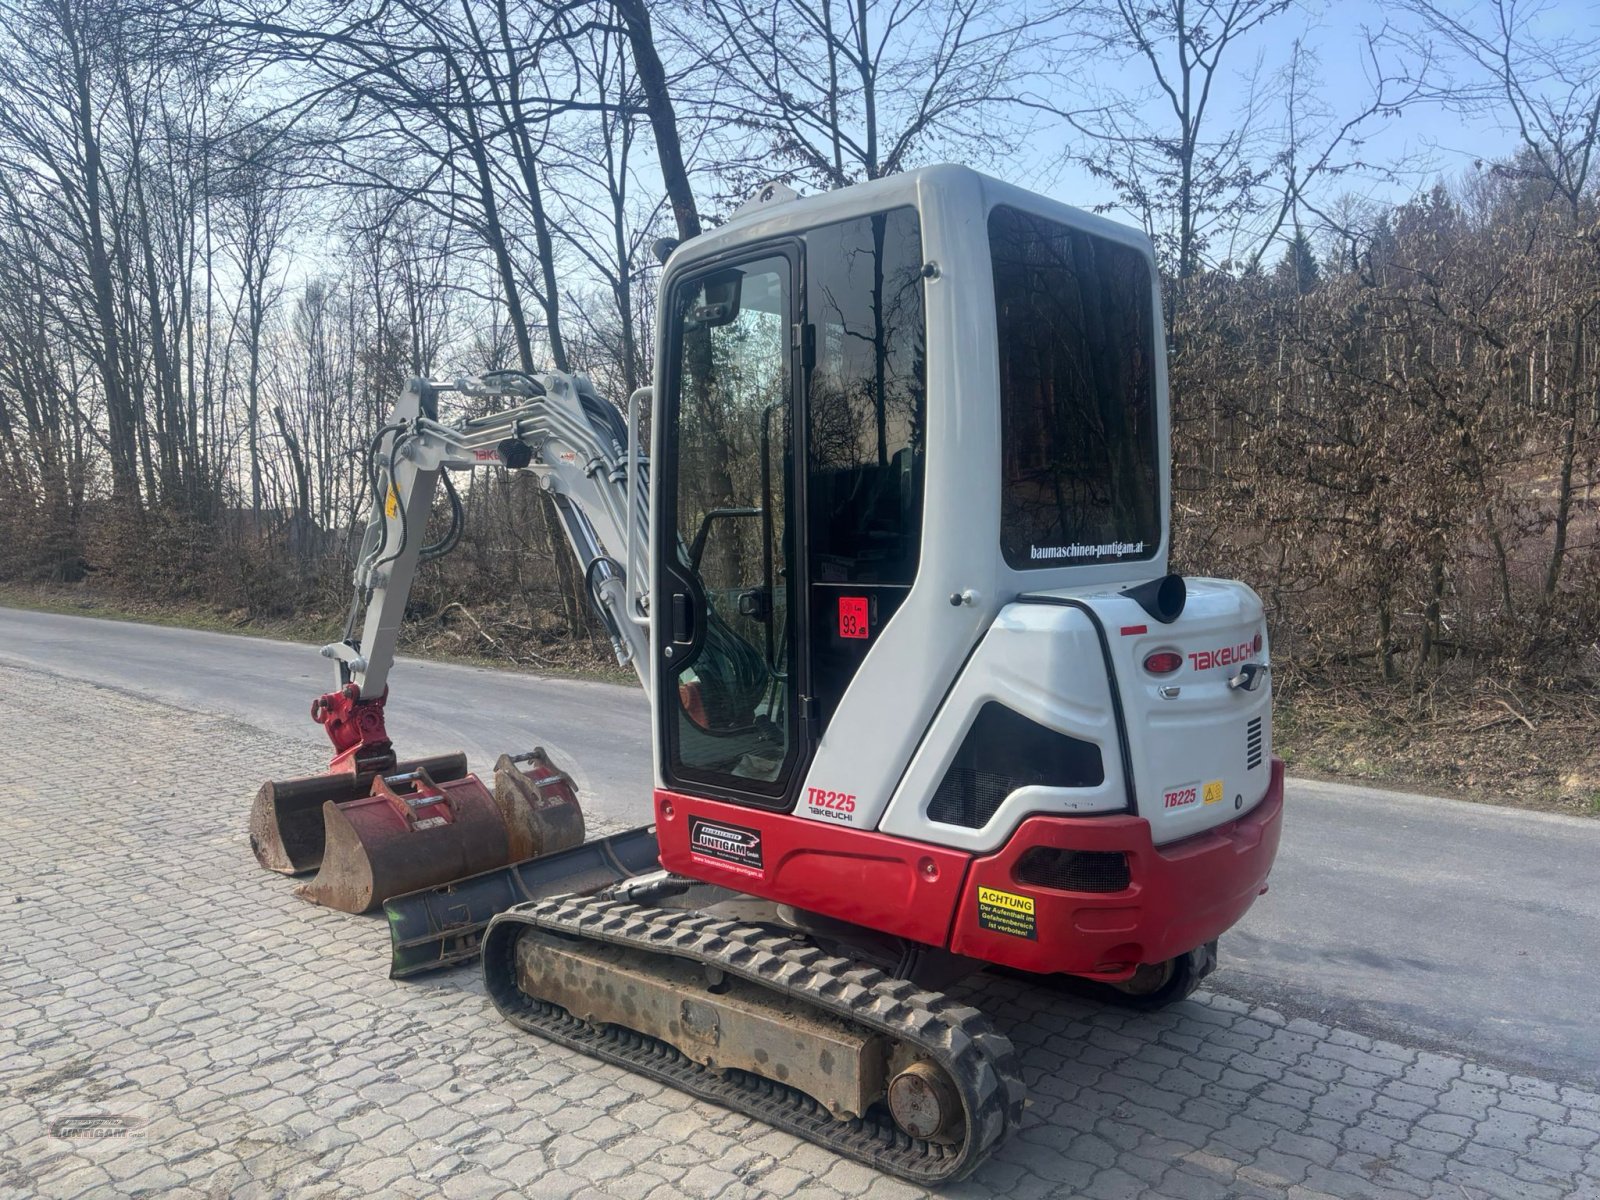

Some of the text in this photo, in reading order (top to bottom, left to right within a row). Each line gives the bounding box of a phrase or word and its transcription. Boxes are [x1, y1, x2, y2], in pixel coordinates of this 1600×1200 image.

[1030, 541, 1143, 559] baumaschinen-puntigam.at
[843, 615, 856, 634] 93
[808, 788, 856, 813] TB225
[1164, 788, 1196, 808] TB225
[808, 807, 853, 821] TAKEUCHI
[981, 891, 1032, 910] ACHTUNG
[980, 904, 991, 912] Der
[992, 908, 1025, 920] Aufenthalt
[982, 912, 1034, 930] Gefahrenbereich
[997, 924, 1028, 936] verboten!
